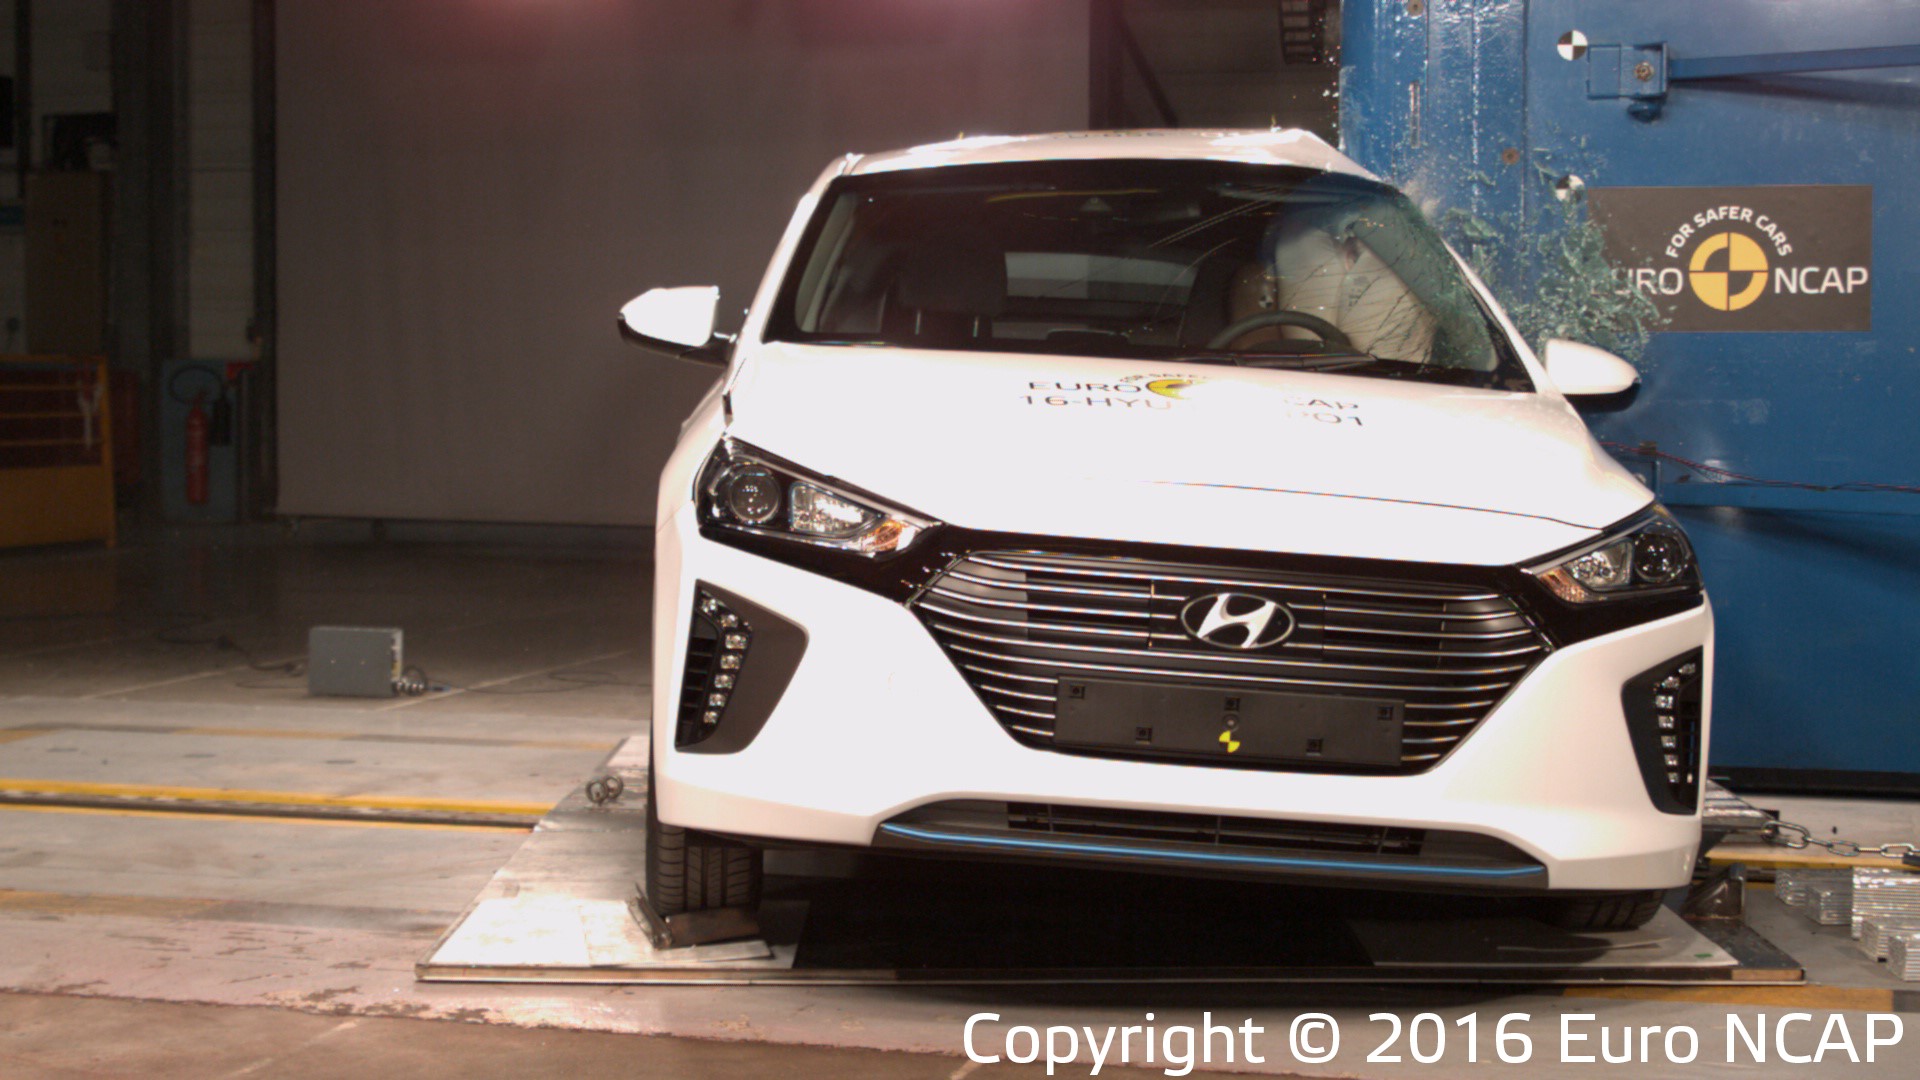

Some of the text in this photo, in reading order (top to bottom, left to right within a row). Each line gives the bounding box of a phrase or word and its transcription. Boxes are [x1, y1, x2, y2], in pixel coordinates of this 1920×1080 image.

[1665, 206, 1793, 258] FOR SAFER CARS
[1600, 266, 1868, 295] URO NCAP
[1028, 381, 1141, 393] EURO
